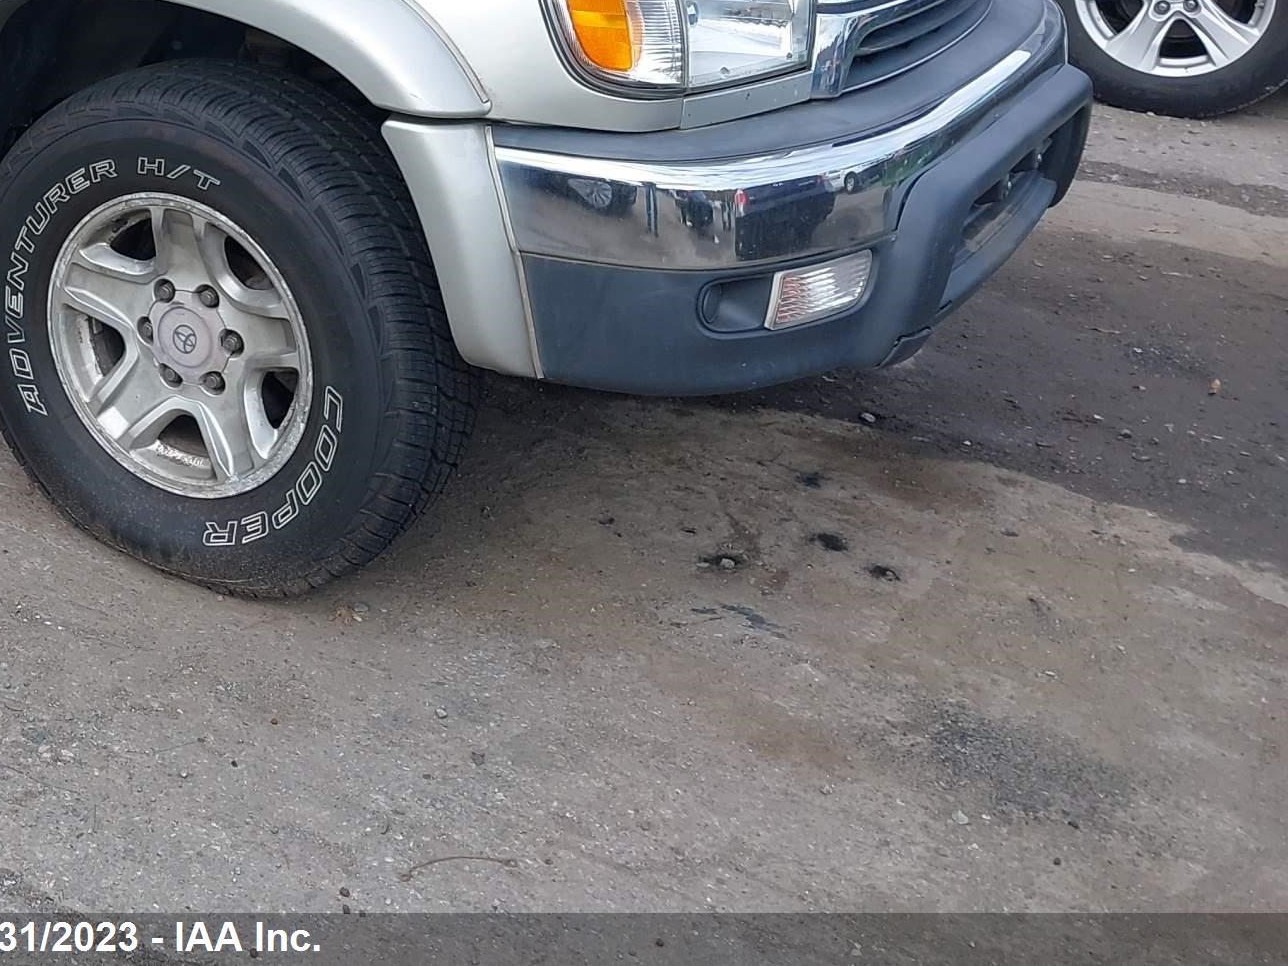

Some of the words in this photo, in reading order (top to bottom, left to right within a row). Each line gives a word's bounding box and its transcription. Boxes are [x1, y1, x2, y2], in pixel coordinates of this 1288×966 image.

[5, 158, 118, 417] ADVENTURER
[136, 156, 221, 191] H/T
[202, 385, 343, 546] COOPER
